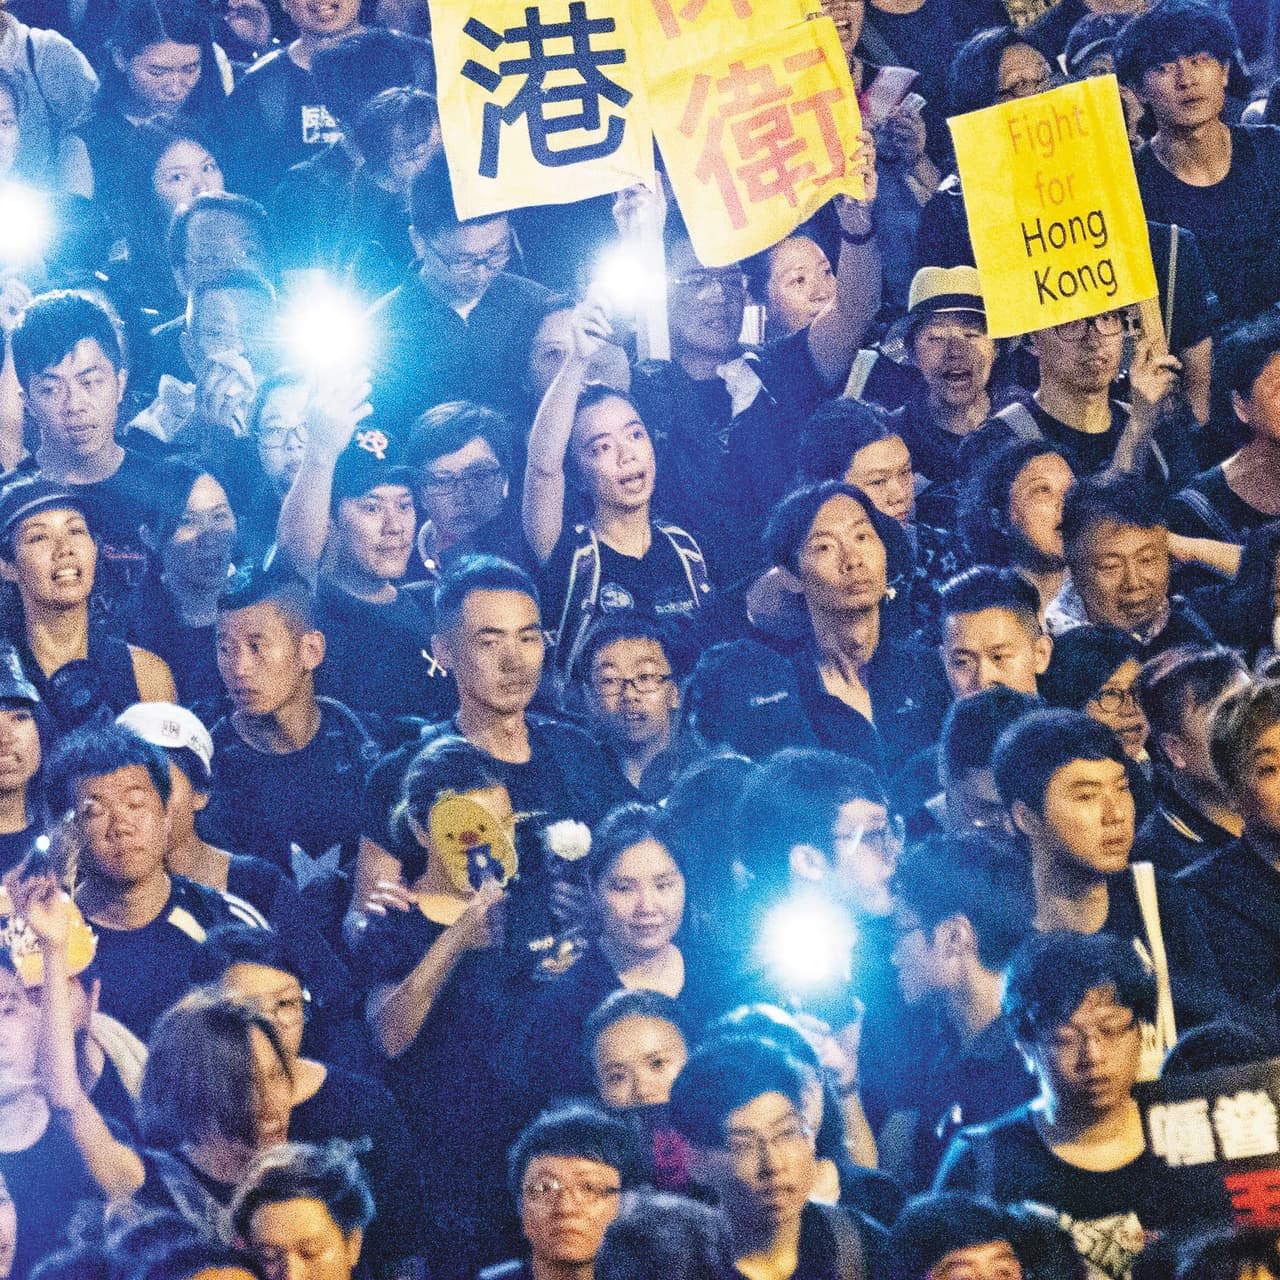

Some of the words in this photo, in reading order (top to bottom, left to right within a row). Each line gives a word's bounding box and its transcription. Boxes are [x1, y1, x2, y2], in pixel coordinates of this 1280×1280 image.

[1007, 104, 1089, 158] Fight
[1035, 171, 1076, 209] for
[1021, 209, 1109, 257] Hong
[1033, 257, 1118, 305] Kong
